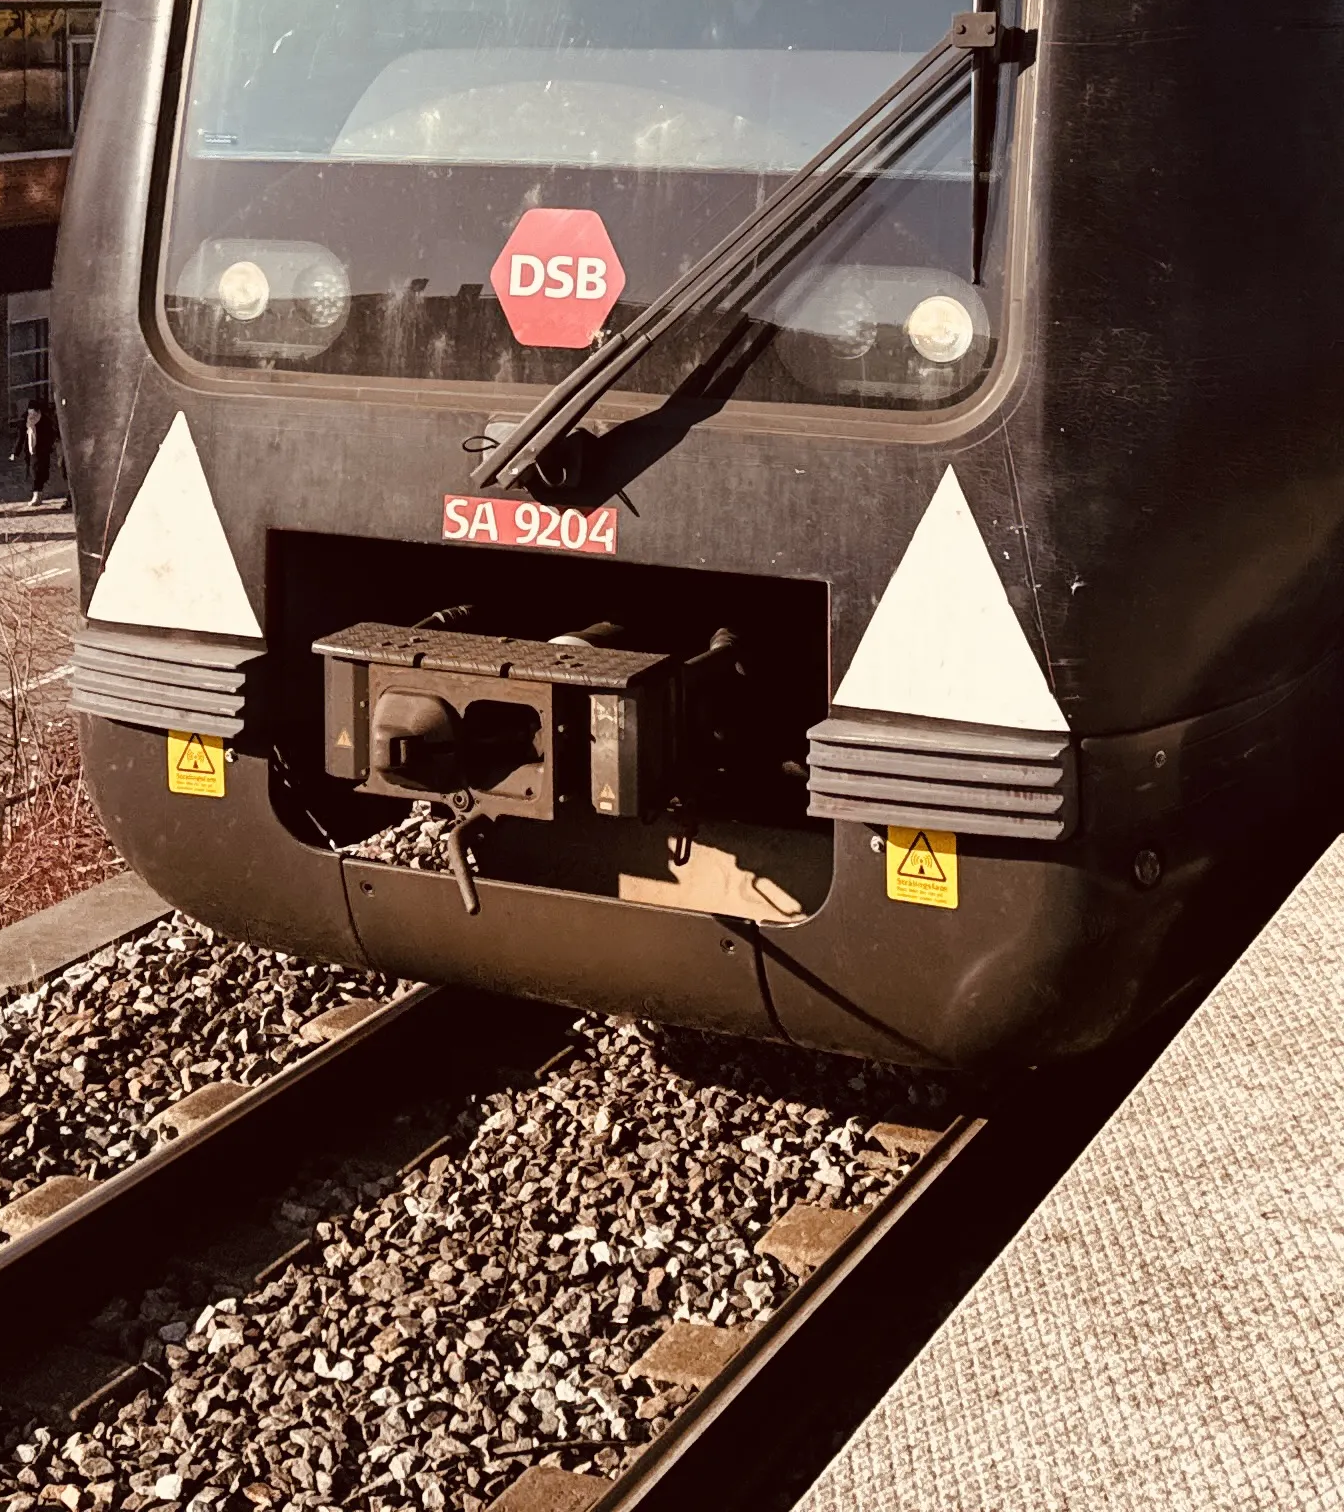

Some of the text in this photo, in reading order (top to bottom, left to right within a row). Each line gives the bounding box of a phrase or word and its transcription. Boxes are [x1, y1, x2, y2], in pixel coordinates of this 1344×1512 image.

[509, 254, 607, 299] DSB
[444, 498, 615, 552] SA 9204
